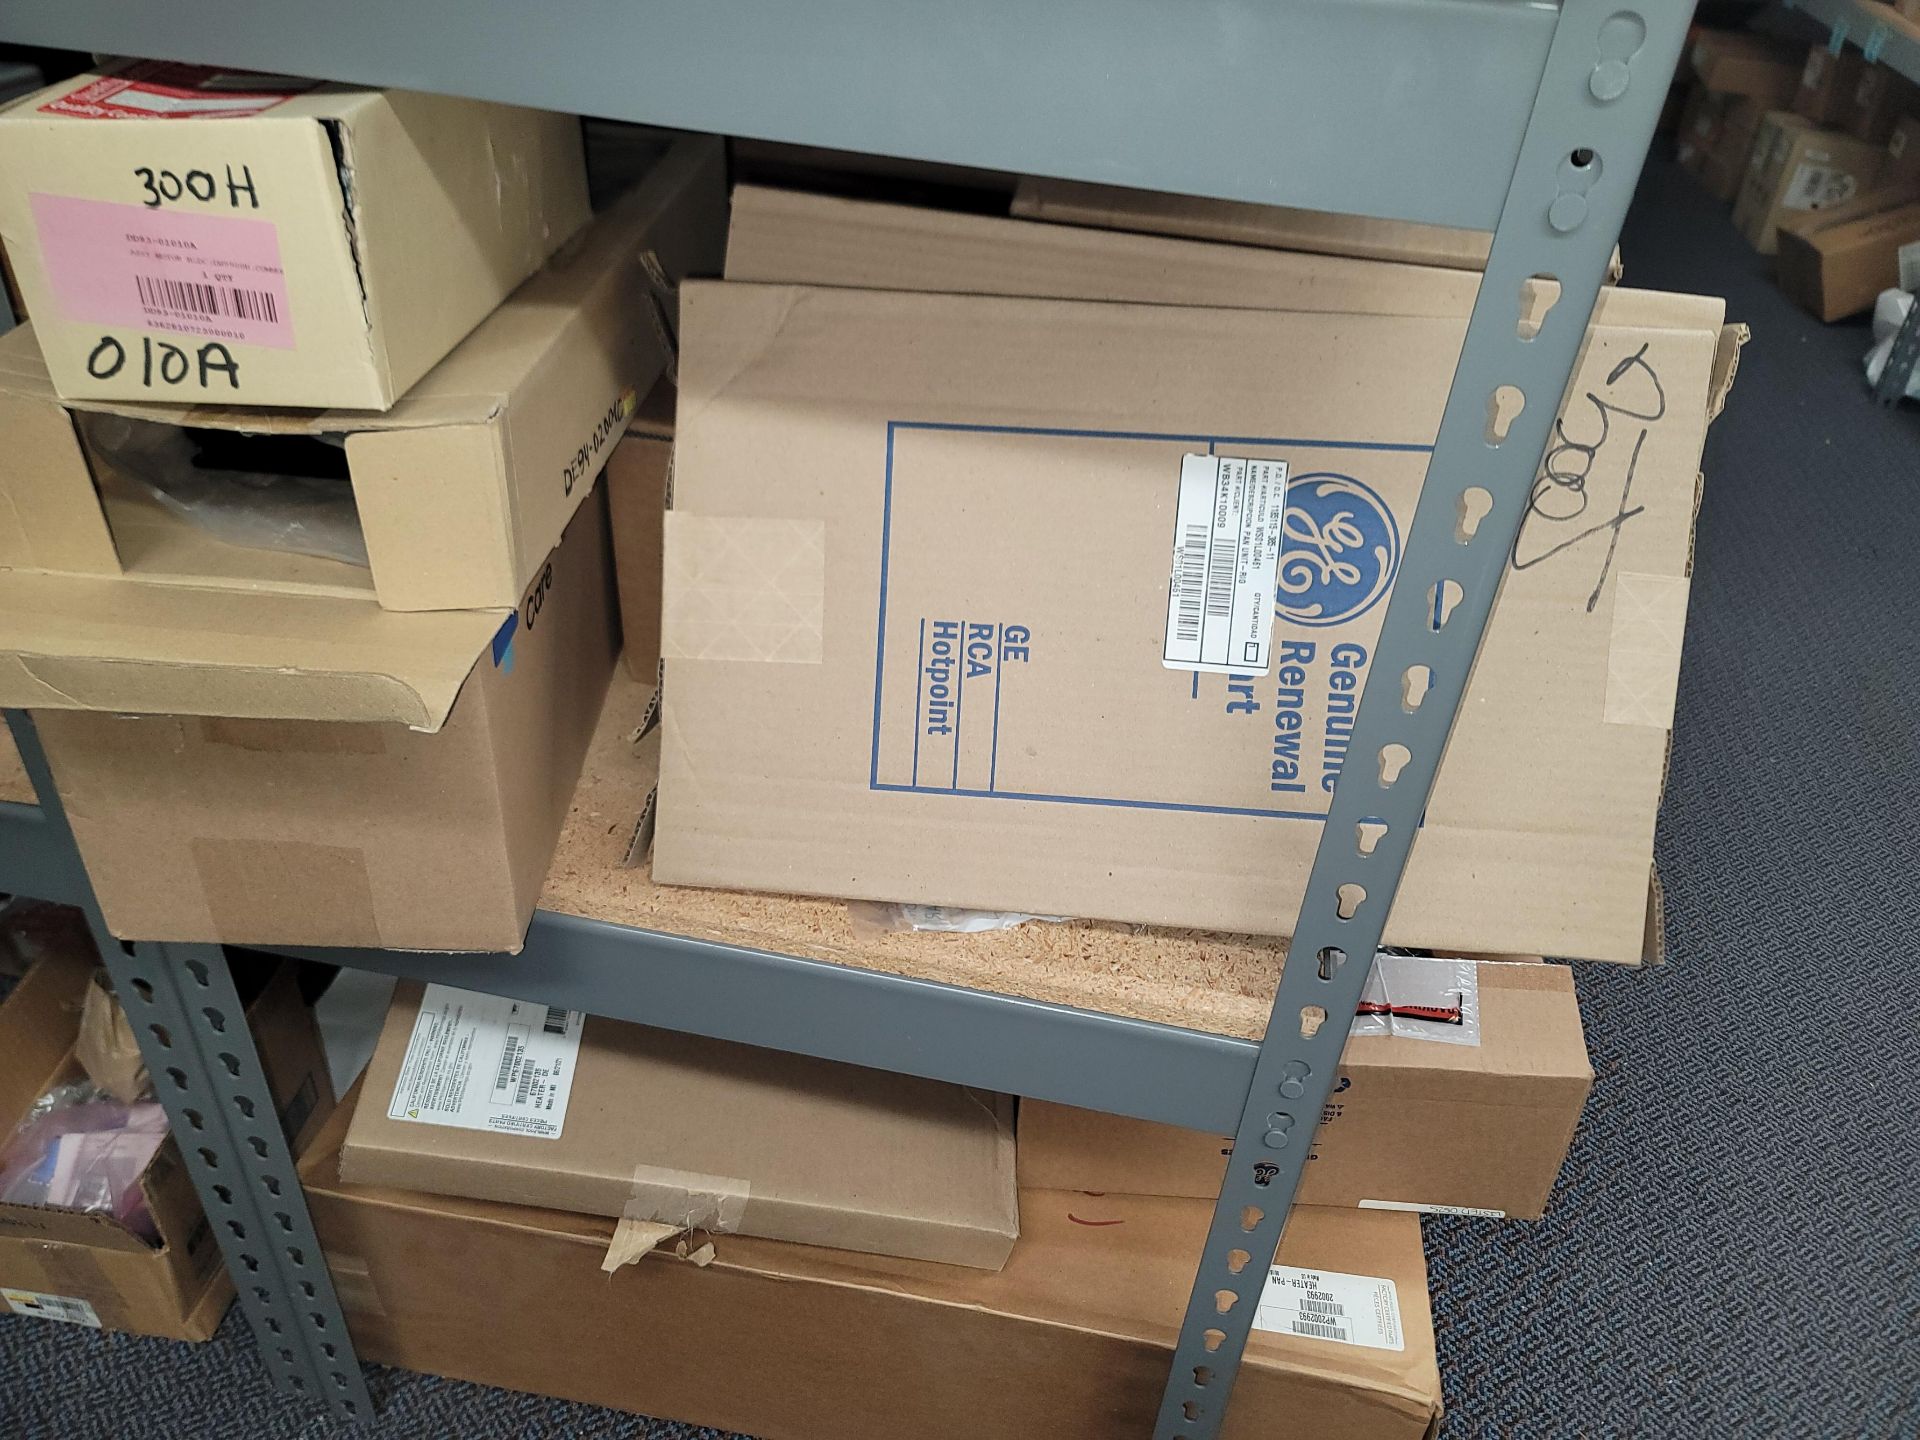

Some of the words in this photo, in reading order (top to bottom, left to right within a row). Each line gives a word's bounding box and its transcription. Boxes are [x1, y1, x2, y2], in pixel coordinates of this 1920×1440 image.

[87, 336, 239, 389] 010A
[1235, 466, 1243, 484] PART
[1217, 463, 1231, 529] WB34K10009
[1242, 530, 1251, 545] PAN
[966, 623, 994, 679] RCA
[1004, 625, 1031, 663] GE
[925, 621, 959, 736] Hotpoint
[1270, 639, 1317, 793] Renewal
[1271, 1276, 1318, 1290] HEATER-PAN
[1307, 1290, 1334, 1302] 2002993
[1298, 1311, 1337, 1326] WP2002993
